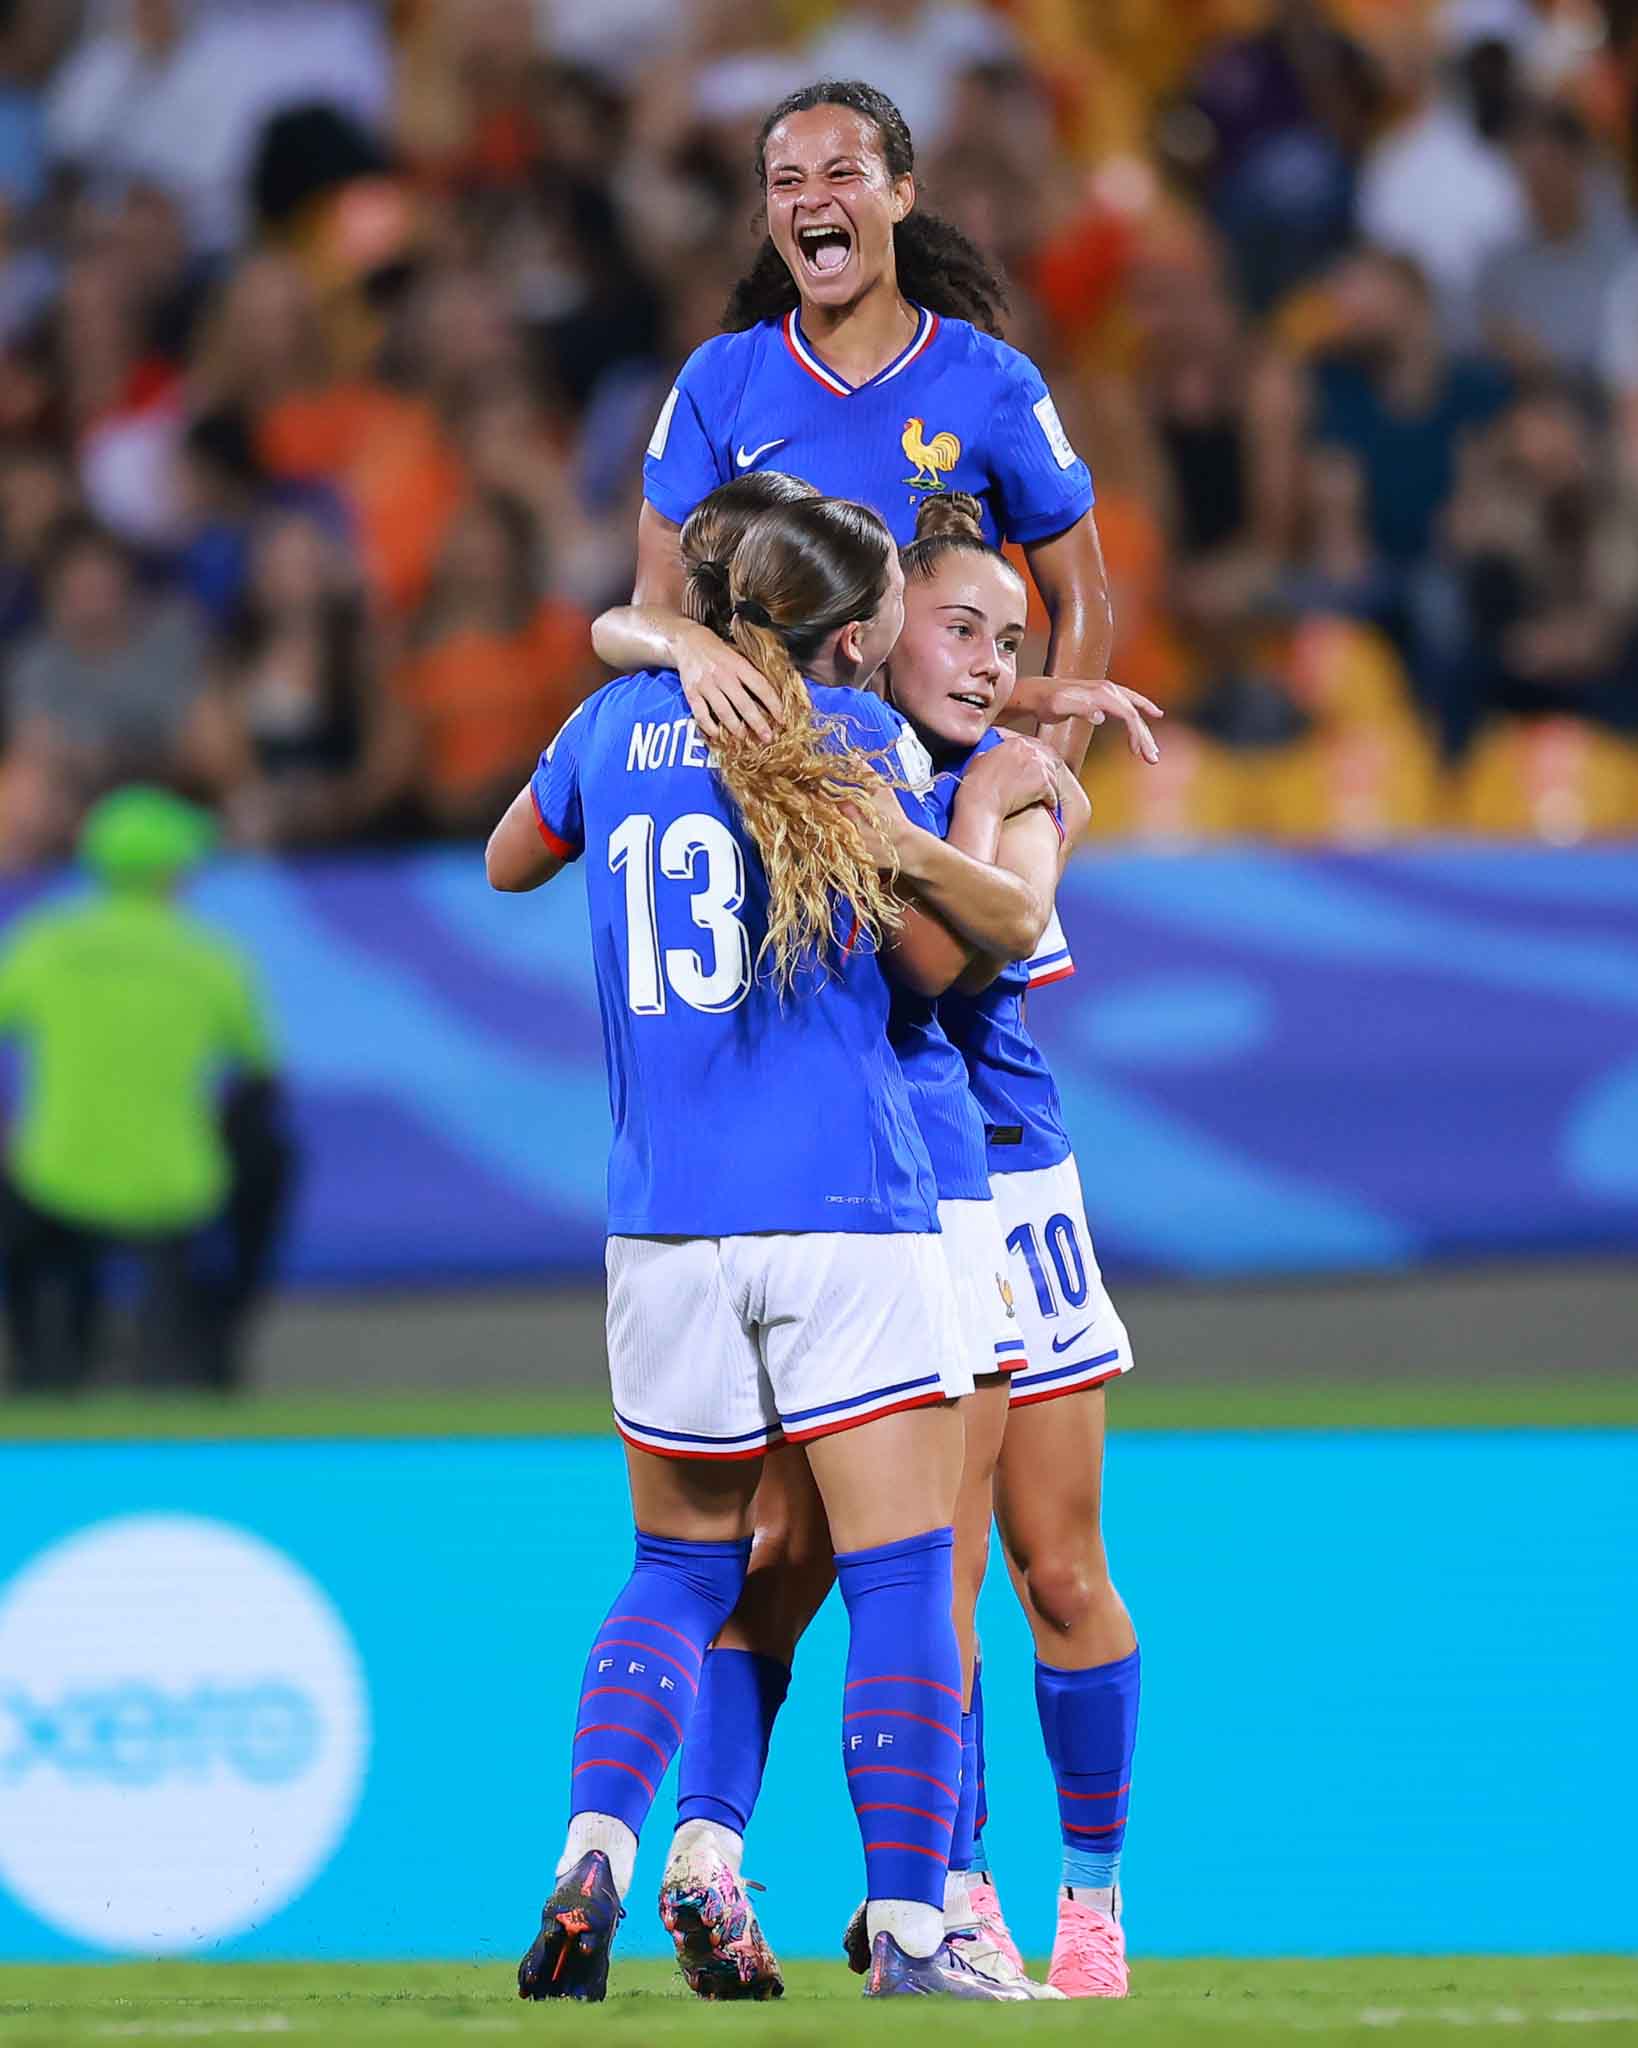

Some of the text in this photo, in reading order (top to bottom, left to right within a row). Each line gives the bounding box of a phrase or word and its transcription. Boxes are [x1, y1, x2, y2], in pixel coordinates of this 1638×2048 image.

[626, 718, 721, 772] NOTE
[608, 813, 751, 1015] 13
[1005, 1213, 1089, 1319] 10
